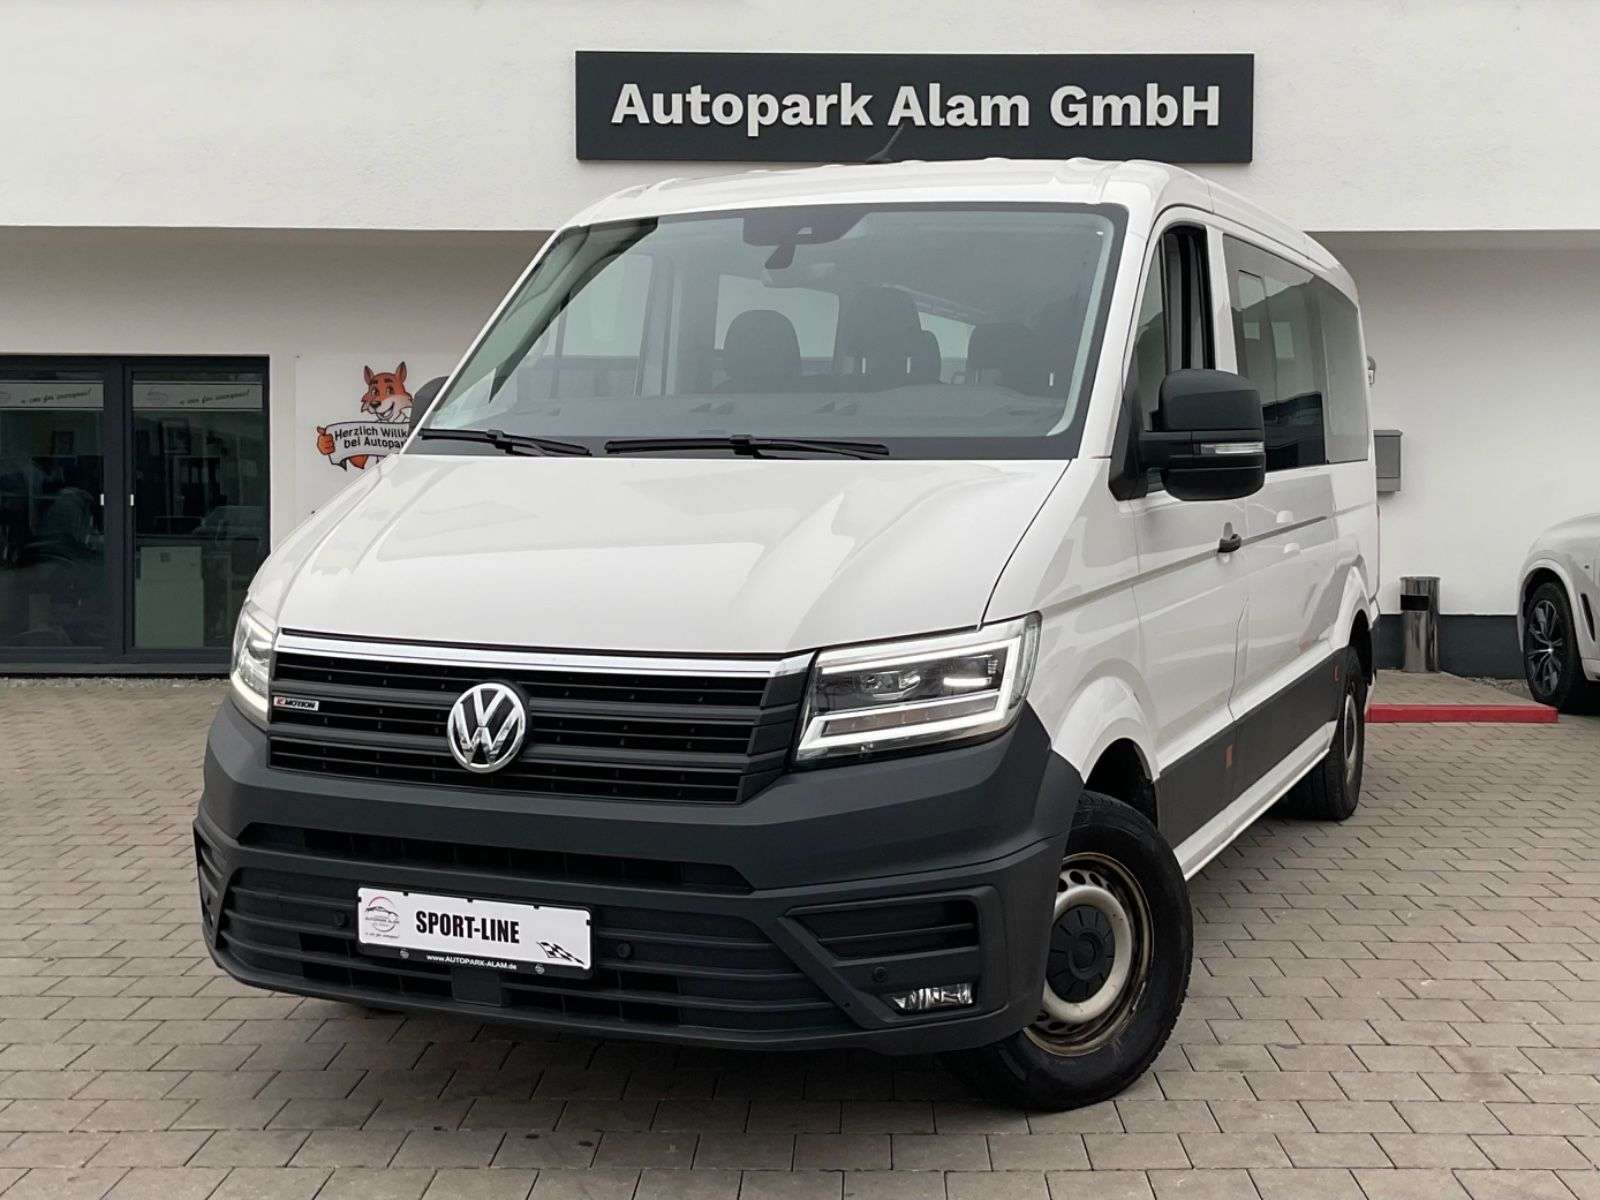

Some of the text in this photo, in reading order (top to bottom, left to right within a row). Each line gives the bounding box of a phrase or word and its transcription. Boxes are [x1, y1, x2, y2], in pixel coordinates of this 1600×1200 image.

[611, 82, 1221, 137] Autopark Alam GmbH
[334, 426, 409, 441] Herzlich Willk
[344, 437, 360, 449] bei
[447, 682, 526, 773] VW
[415, 910, 520, 944] SPORT-LINE
[426, 955, 517, 970] www.AUTOPARK-ALAM.de
